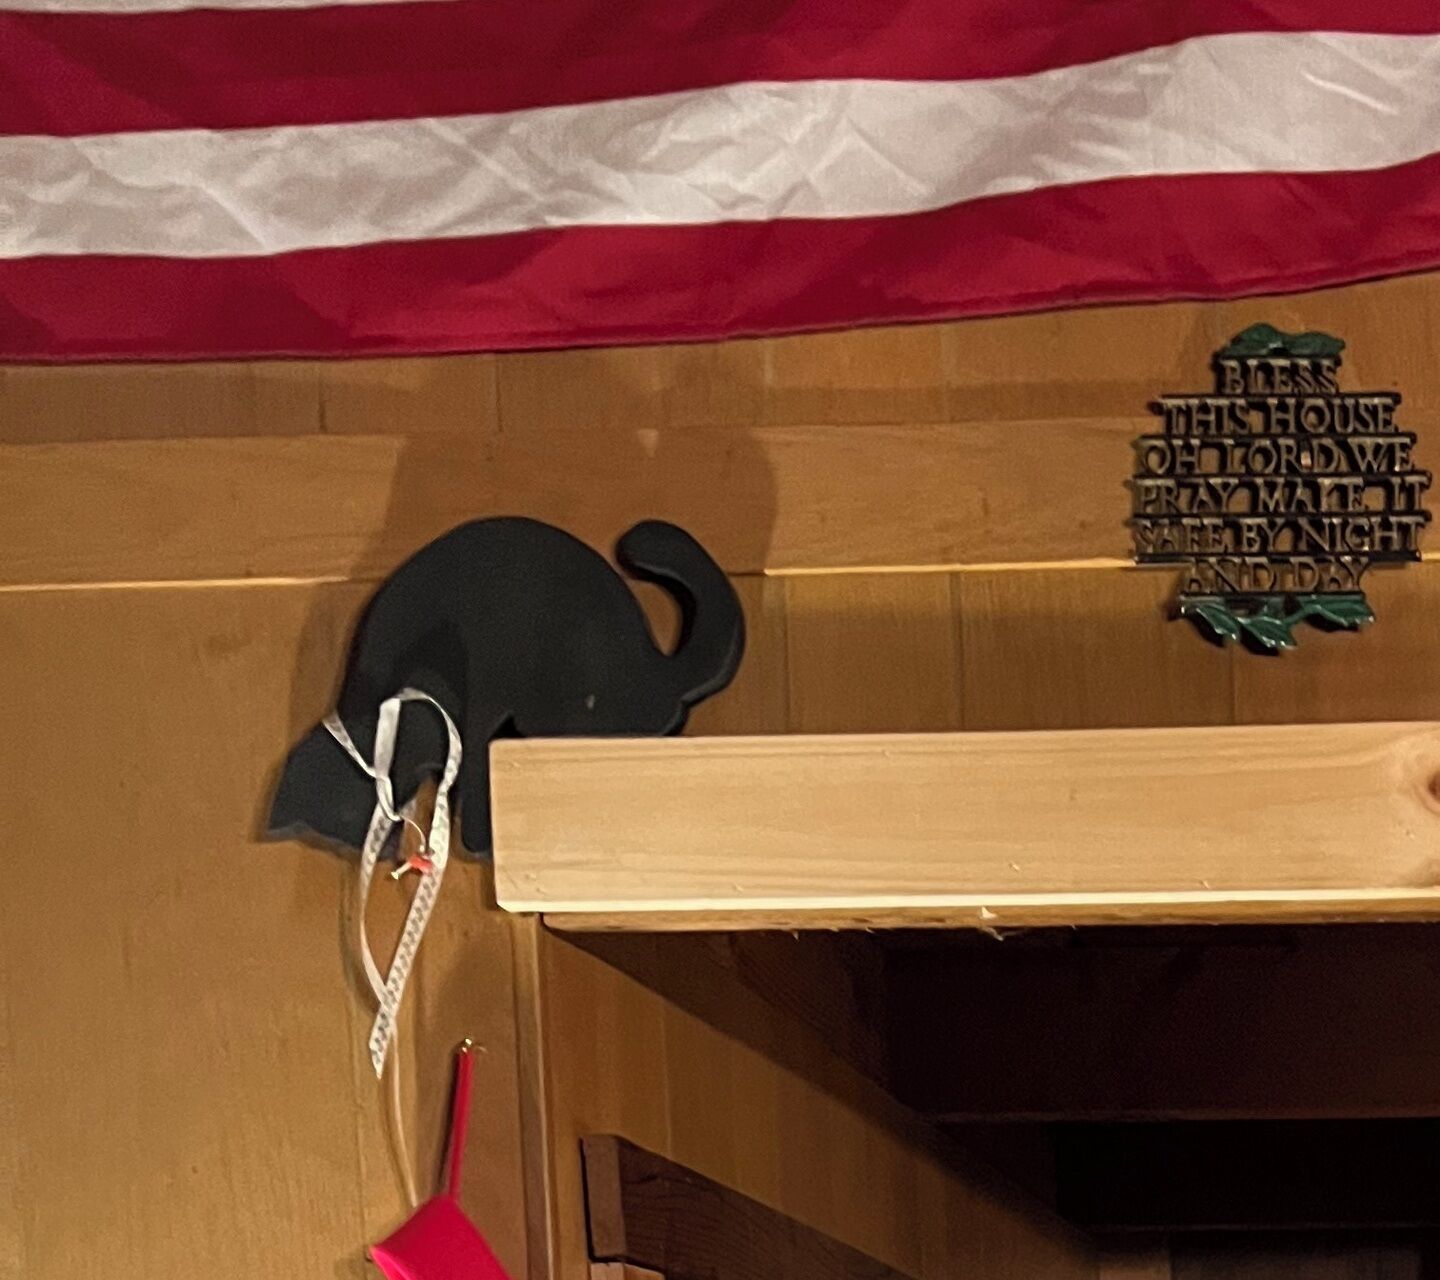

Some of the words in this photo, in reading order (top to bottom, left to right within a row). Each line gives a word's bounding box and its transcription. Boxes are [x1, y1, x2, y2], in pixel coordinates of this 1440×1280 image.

[1219, 358, 1339, 394] BLESS
[1162, 398, 1250, 434] THIS
[1268, 397, 1396, 433] HOUSE
[1140, 438, 1200, 474] OH
[1223, 438, 1341, 474] LORD
[1347, 437, 1415, 472] WE
[1133, 478, 1239, 514] PRAY
[1256, 477, 1367, 512] MAKE
[1390, 476, 1427, 511] IT
[1133, 517, 1228, 553] SAFE
[1240, 517, 1286, 553] BY
[1298, 515, 1427, 551] NIGHT
[1186, 556, 1277, 592] AND
[1292, 556, 1370, 591] DAY
